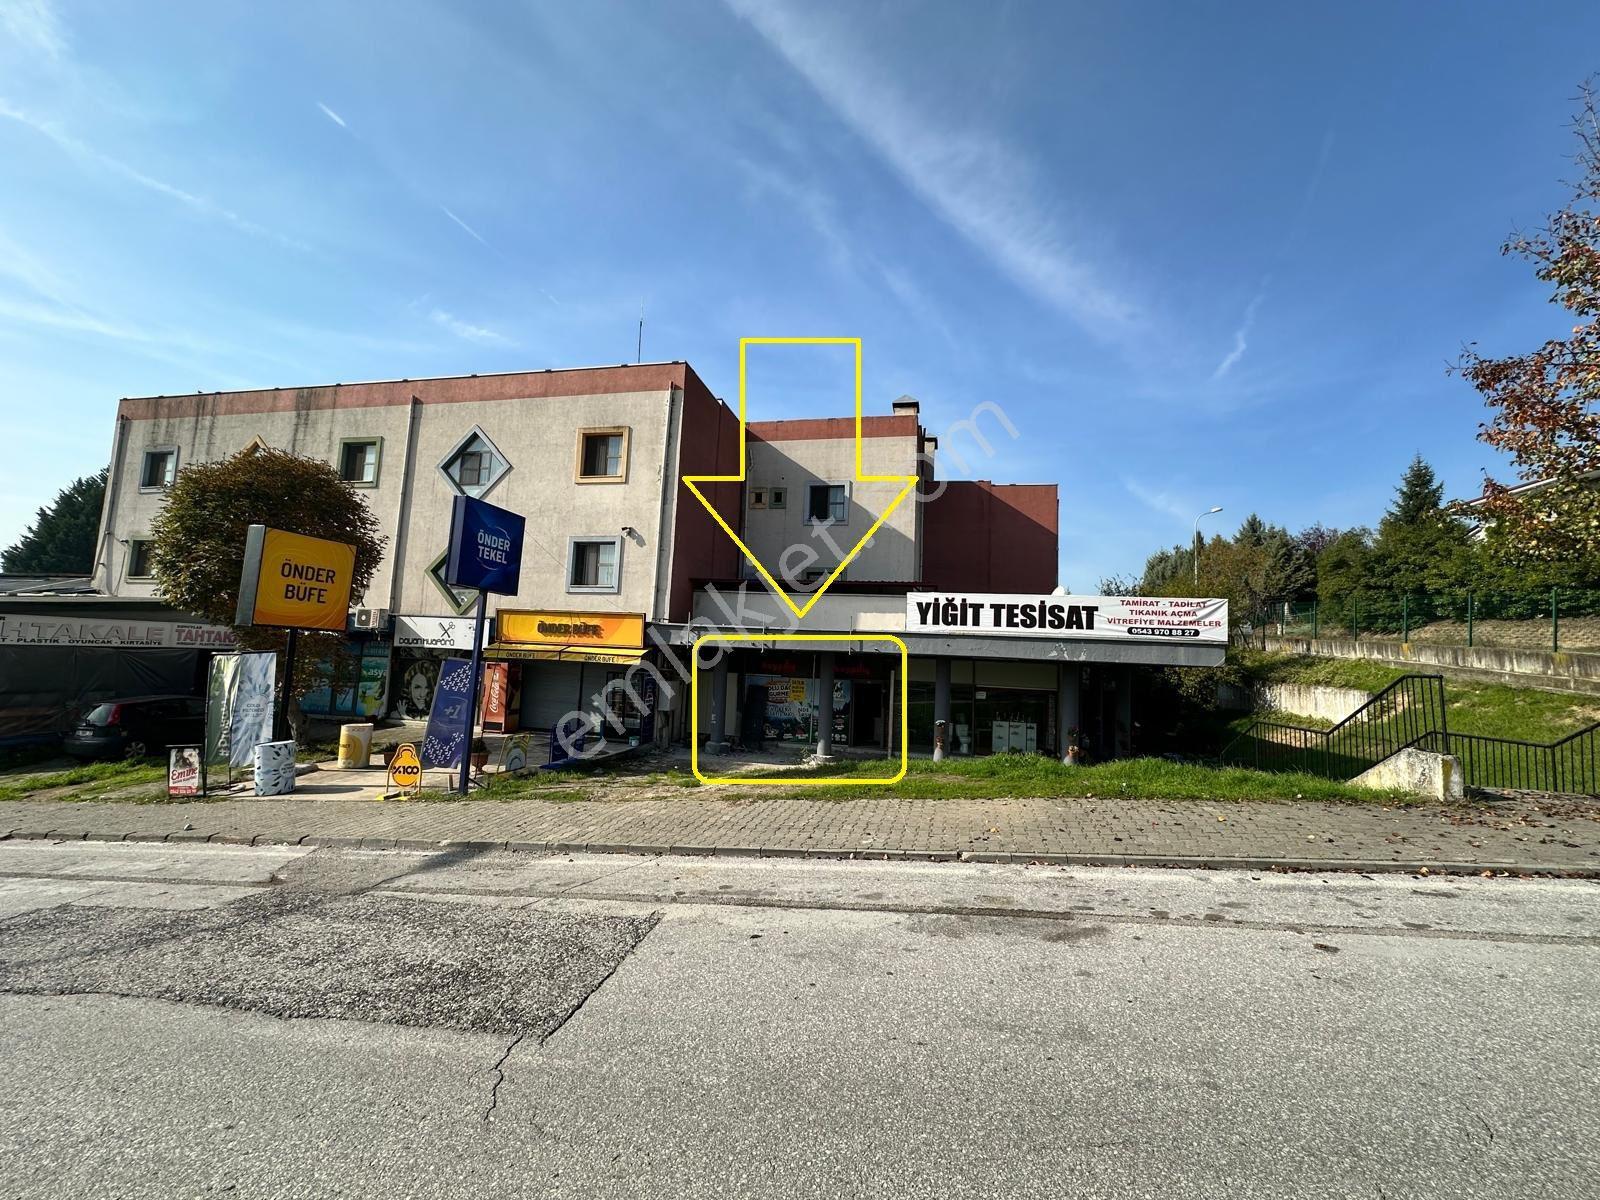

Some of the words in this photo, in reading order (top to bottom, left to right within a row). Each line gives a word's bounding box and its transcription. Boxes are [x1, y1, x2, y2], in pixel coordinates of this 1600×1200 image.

[477, 529, 511, 552] ÖNDER
[477, 545, 508, 565] TEKEL
[280, 558, 337, 585] ÖNDER
[284, 581, 328, 604] BÜFE
[916, 597, 984, 627] YİĞİT
[990, 600, 1099, 630] TESİSAT
[1120, 598, 1161, 607] TAMİRAT
[1169, 600, 1208, 609] TADİLAT
[1129, 609, 1168, 617] TIKANIK
[1170, 609, 1198, 618] AÇMA
[1107, 617, 1155, 626] VİTREFİYE
[1157, 619, 1222, 627] MALZEMELER
[392, 765, 420, 776] %100
